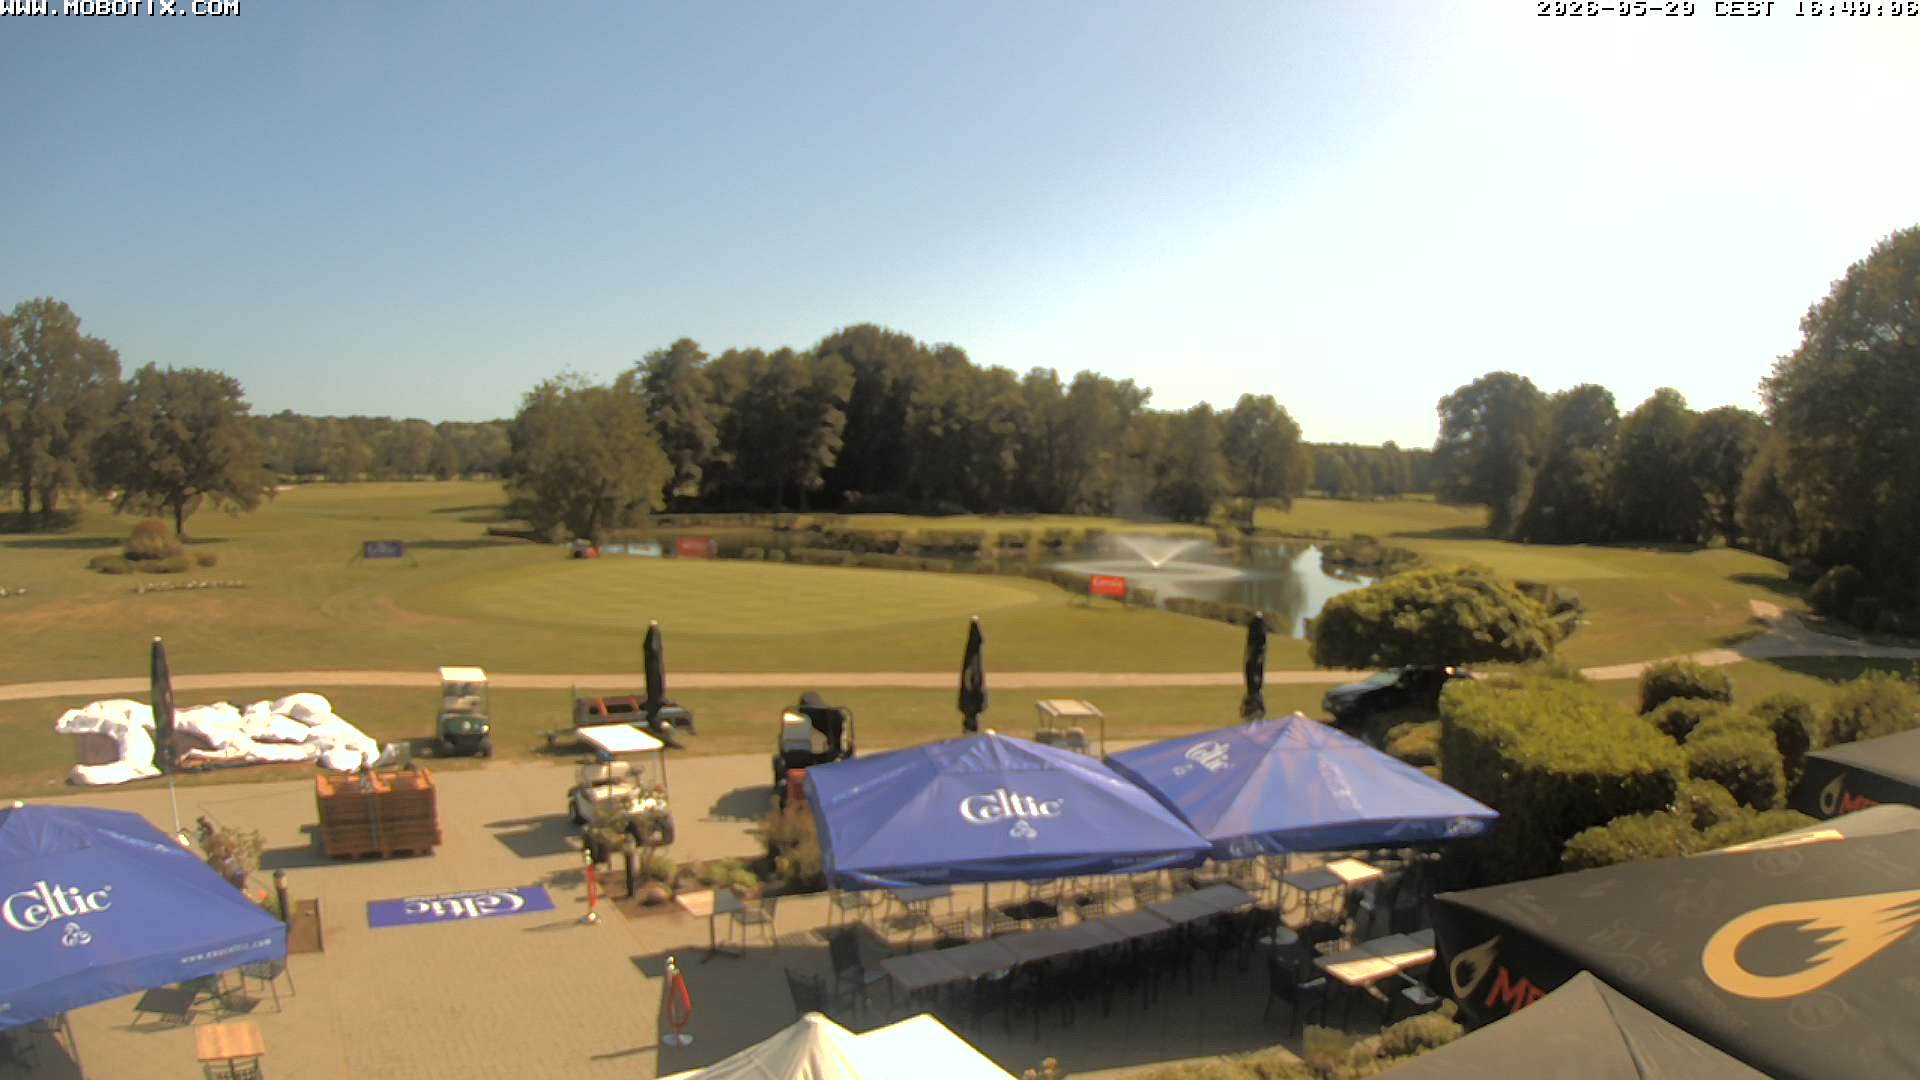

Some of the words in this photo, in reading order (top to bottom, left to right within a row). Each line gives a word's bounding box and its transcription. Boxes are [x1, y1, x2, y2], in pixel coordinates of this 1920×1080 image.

[959, 787, 1064, 823] Celtic
[2, 880, 112, 932] Celtic
[404, 891, 525, 917] Celtic
